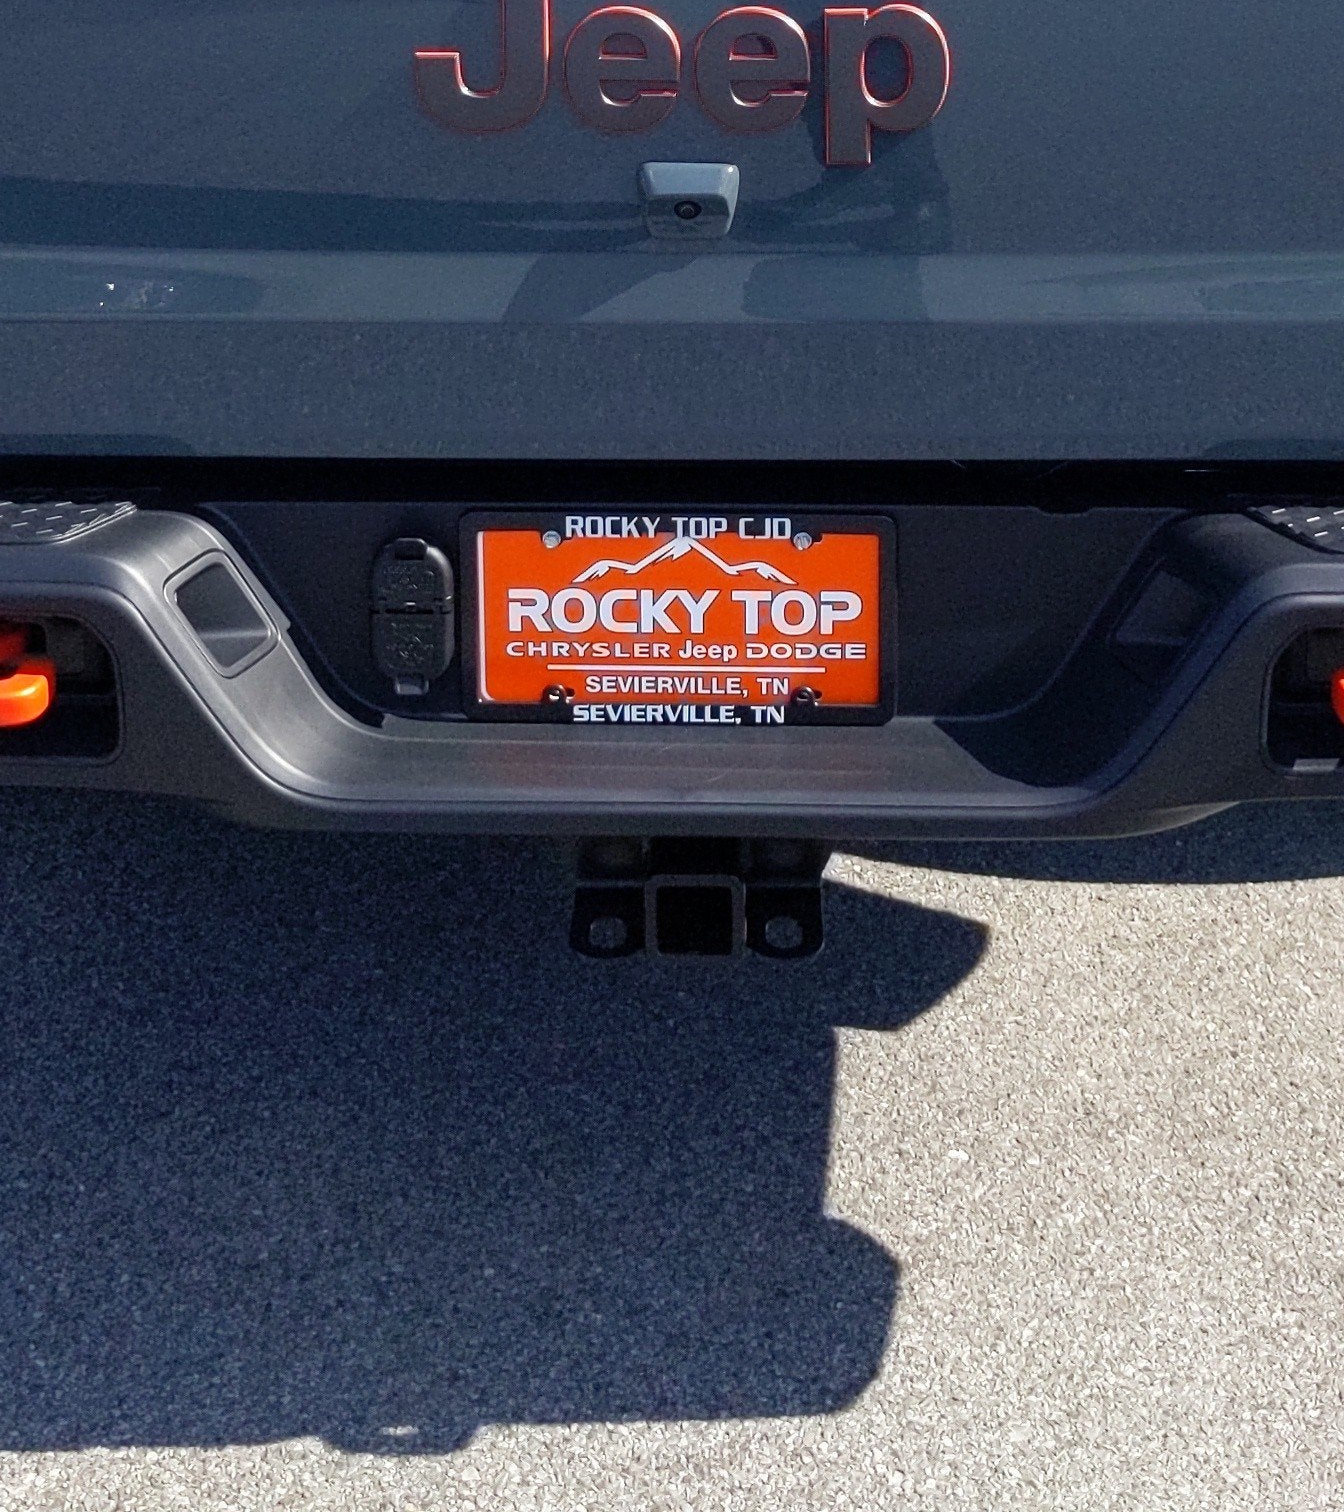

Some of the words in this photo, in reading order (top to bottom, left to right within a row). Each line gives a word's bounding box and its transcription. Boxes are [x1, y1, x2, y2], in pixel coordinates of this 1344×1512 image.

[564, 515, 662, 539] ROCKY
[671, 516, 729, 540] TOP
[738, 517, 793, 541] CJD
[506, 586, 721, 635] ROCKY
[730, 588, 864, 637] TOP
[505, 640, 672, 659] CHRYSLER
[677, 639, 739, 662] Jeep
[745, 642, 867, 660] DODGE
[584, 675, 750, 698] SEVIERVILLE,
[756, 676, 790, 696] TN
[572, 703, 742, 726] SEVIERVILLE,
[750, 704, 786, 724] TN
